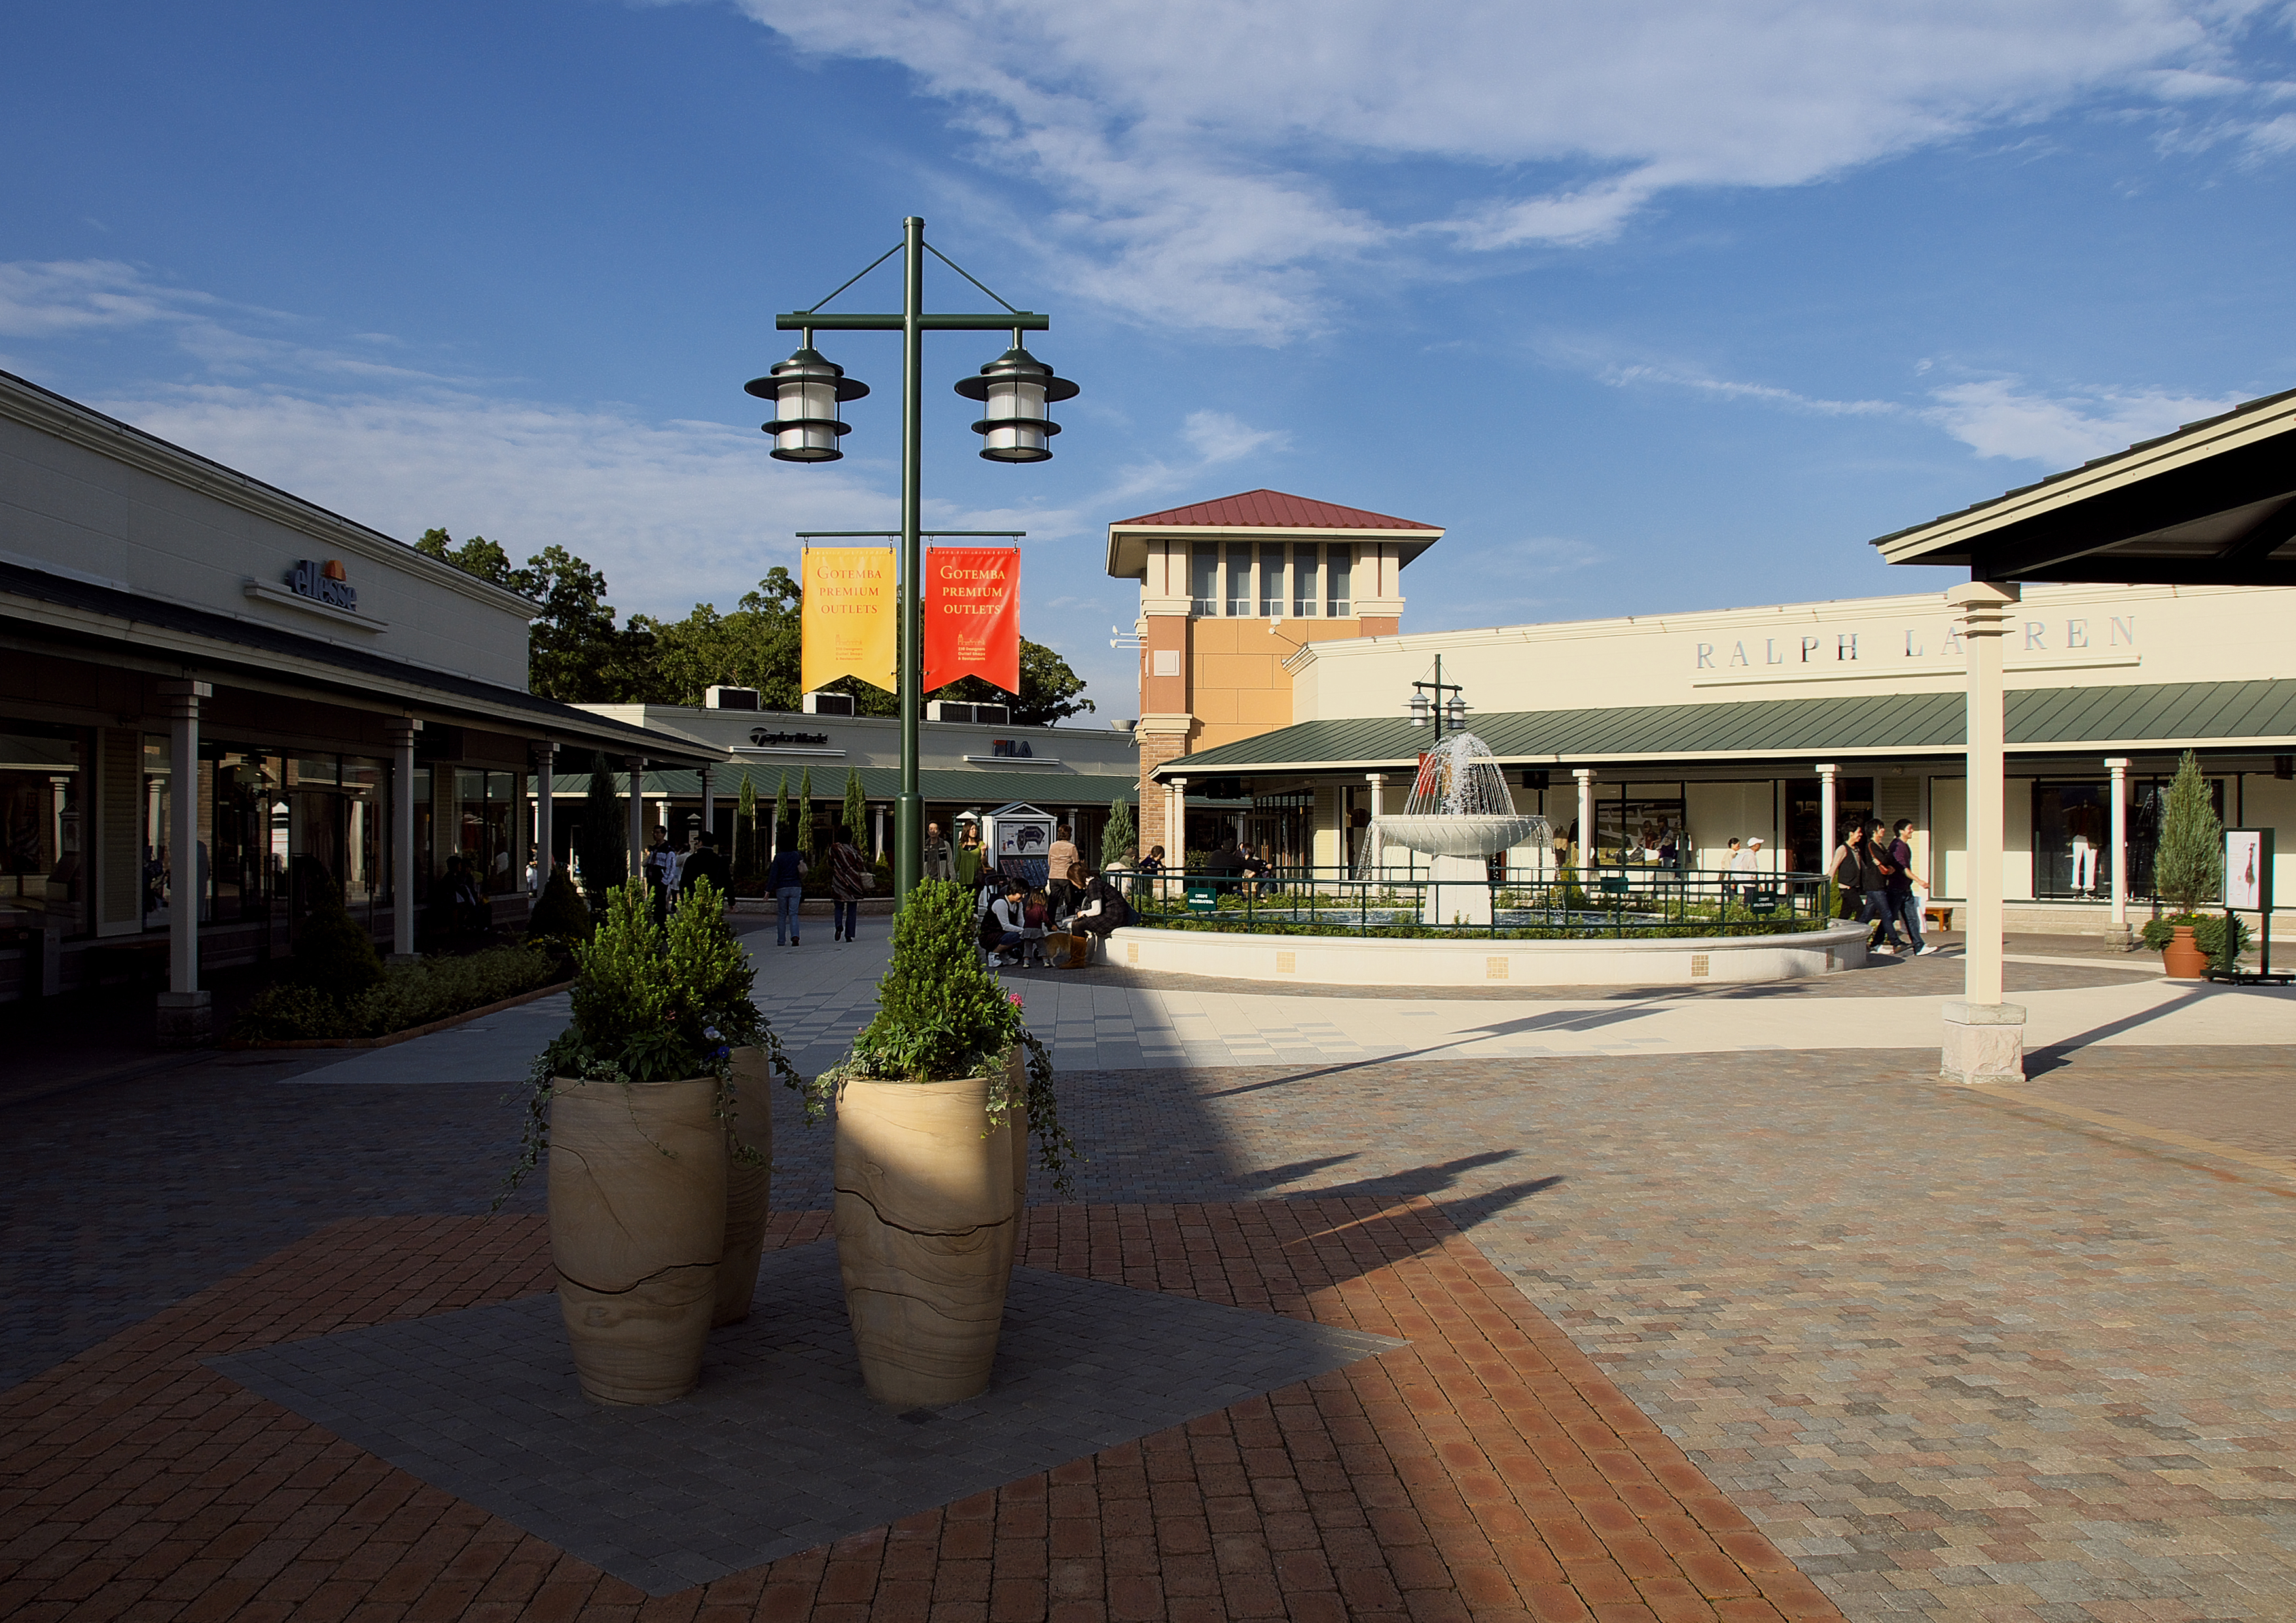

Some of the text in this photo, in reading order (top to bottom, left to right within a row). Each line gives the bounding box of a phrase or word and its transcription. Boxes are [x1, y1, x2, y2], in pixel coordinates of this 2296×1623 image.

[289, 560, 357, 612] ellesse
[819, 587, 879, 596] PREMIUM
[942, 587, 1003, 597] PREMIUM
[821, 604, 878, 614] OUTLETS
[943, 604, 1001, 615] OUTLETS
[1695, 615, 2136, 669] RALPH LAREN
[749, 726, 829, 747] TaylorMade
[993, 739, 1033, 758] FILA
